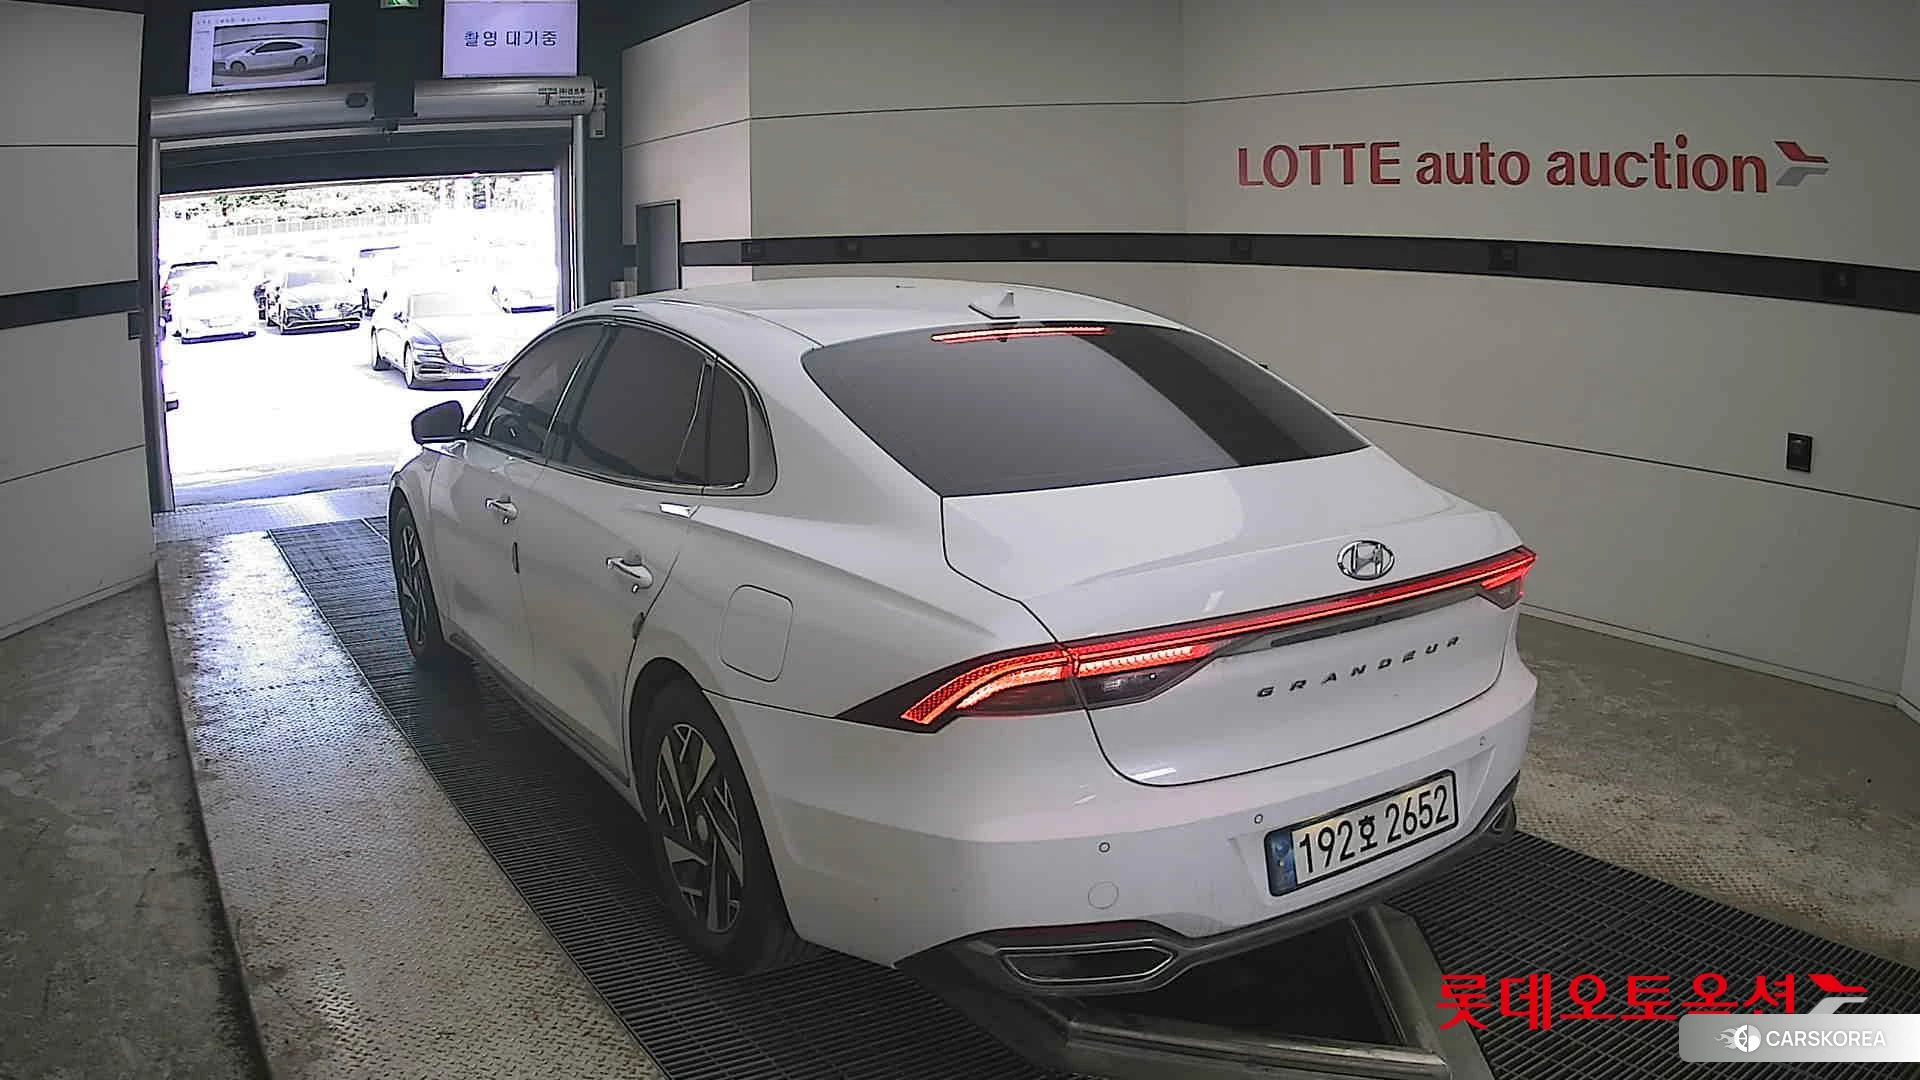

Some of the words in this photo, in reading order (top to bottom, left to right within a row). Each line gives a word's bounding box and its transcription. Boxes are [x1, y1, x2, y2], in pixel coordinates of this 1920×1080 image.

[505, 30, 558, 47] 대기중
[1238, 141, 1401, 188] LOTTE
[1415, 142, 1531, 186] auto
[1546, 134, 1768, 194] auction
[1256, 636, 1460, 698] GRANDEUR
[1299, 814, 1378, 874] 192호
[1384, 784, 1449, 844] 2652
